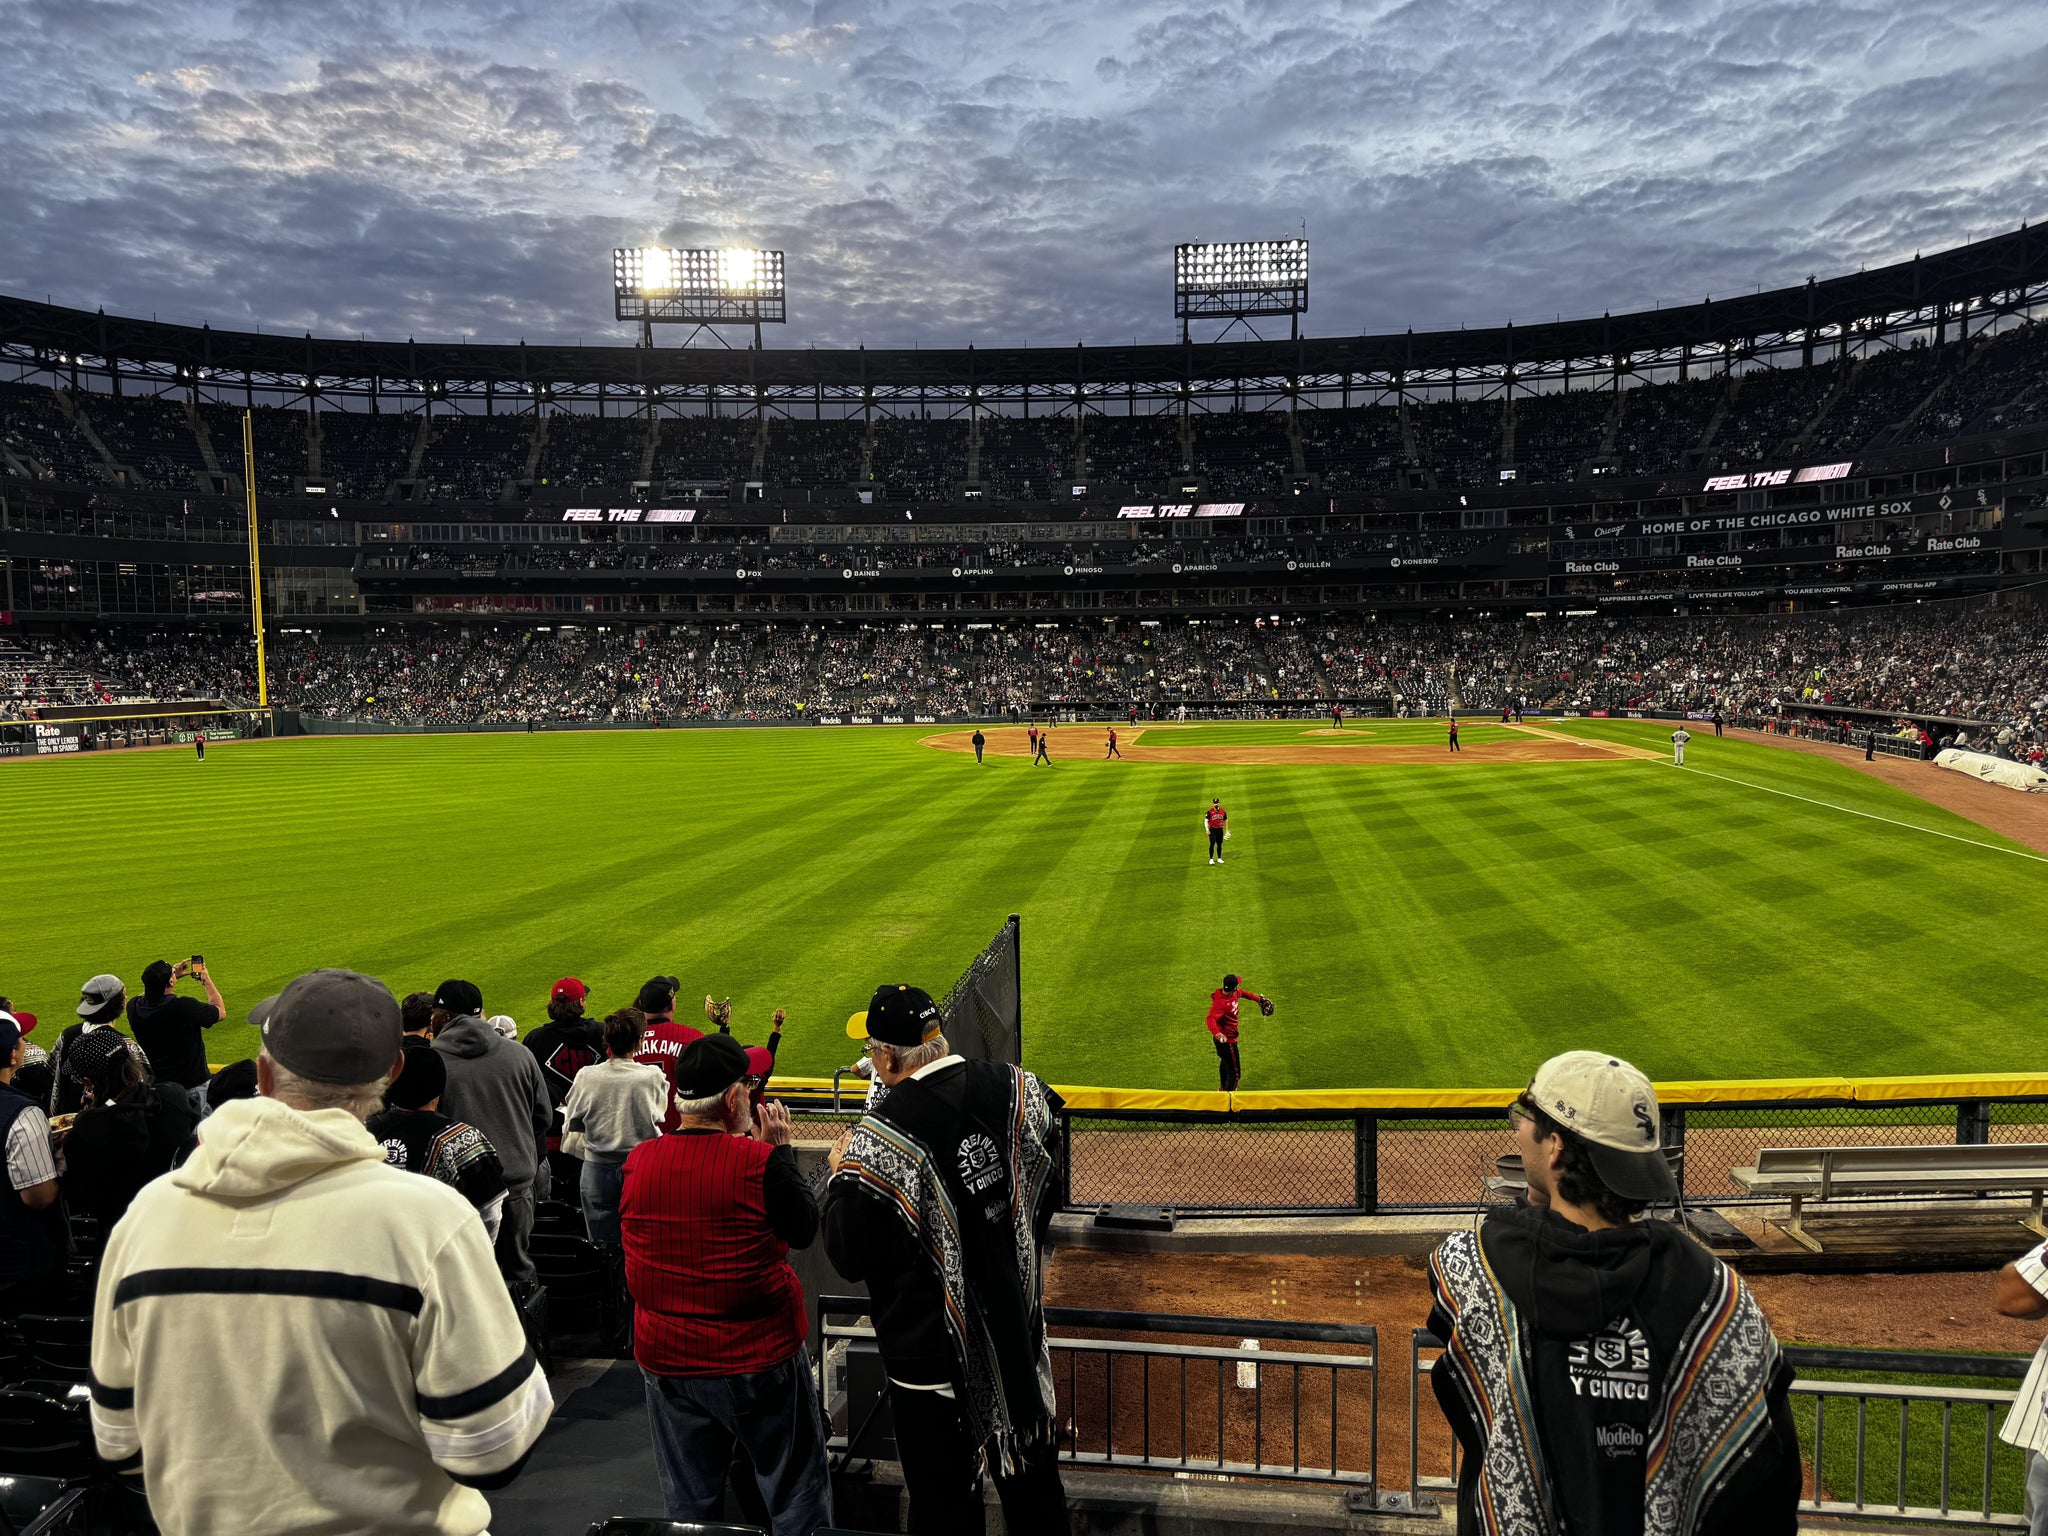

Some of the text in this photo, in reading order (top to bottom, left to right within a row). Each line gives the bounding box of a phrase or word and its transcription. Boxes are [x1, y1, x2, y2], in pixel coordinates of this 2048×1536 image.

[1703, 474, 1748, 491] FEEL
[1753, 469, 1792, 487] THE
[562, 509, 603, 521] FEEL
[608, 509, 642, 521] THE
[1117, 505, 1155, 518] FEEL
[1159, 504, 1193, 517] THE
[1642, 501, 1912, 534] HOME OF THE CHICAGO WHITE SOX
[1594, 524, 1626, 538] Chicago
[1927, 536, 1981, 551] Rate Club
[1836, 544, 1891, 558] Rate Club
[1299, 561, 1331, 569] GUILLÉN
[1402, 558, 1439, 566] KONERKO
[1565, 561, 1620, 573] Rate Club
[1687, 555, 1742, 567] Rate Club
[820, 717, 841, 725] Modelo
[852, 716, 873, 724] Modelo
[883, 716, 904, 724] Modelo
[914, 715, 935, 723] Modelo
[36, 724, 61, 737] Rate
[38, 736, 78, 746] THE ONLY LENDER
[37, 746, 53, 754] 100%
[59, 744, 79, 753] SPANISH
[634, 1039, 683, 1058] AKAMI
[381, 1138, 408, 1164] REINTA
[957, 1133, 1000, 1178] LA TREINTA
[966, 1167, 1004, 1195] Y CINCO
[1568, 1340, 1590, 1365] LA
[1570, 1375, 1649, 1400] Y CINCO
[1596, 1425, 1644, 1447] Modelo
